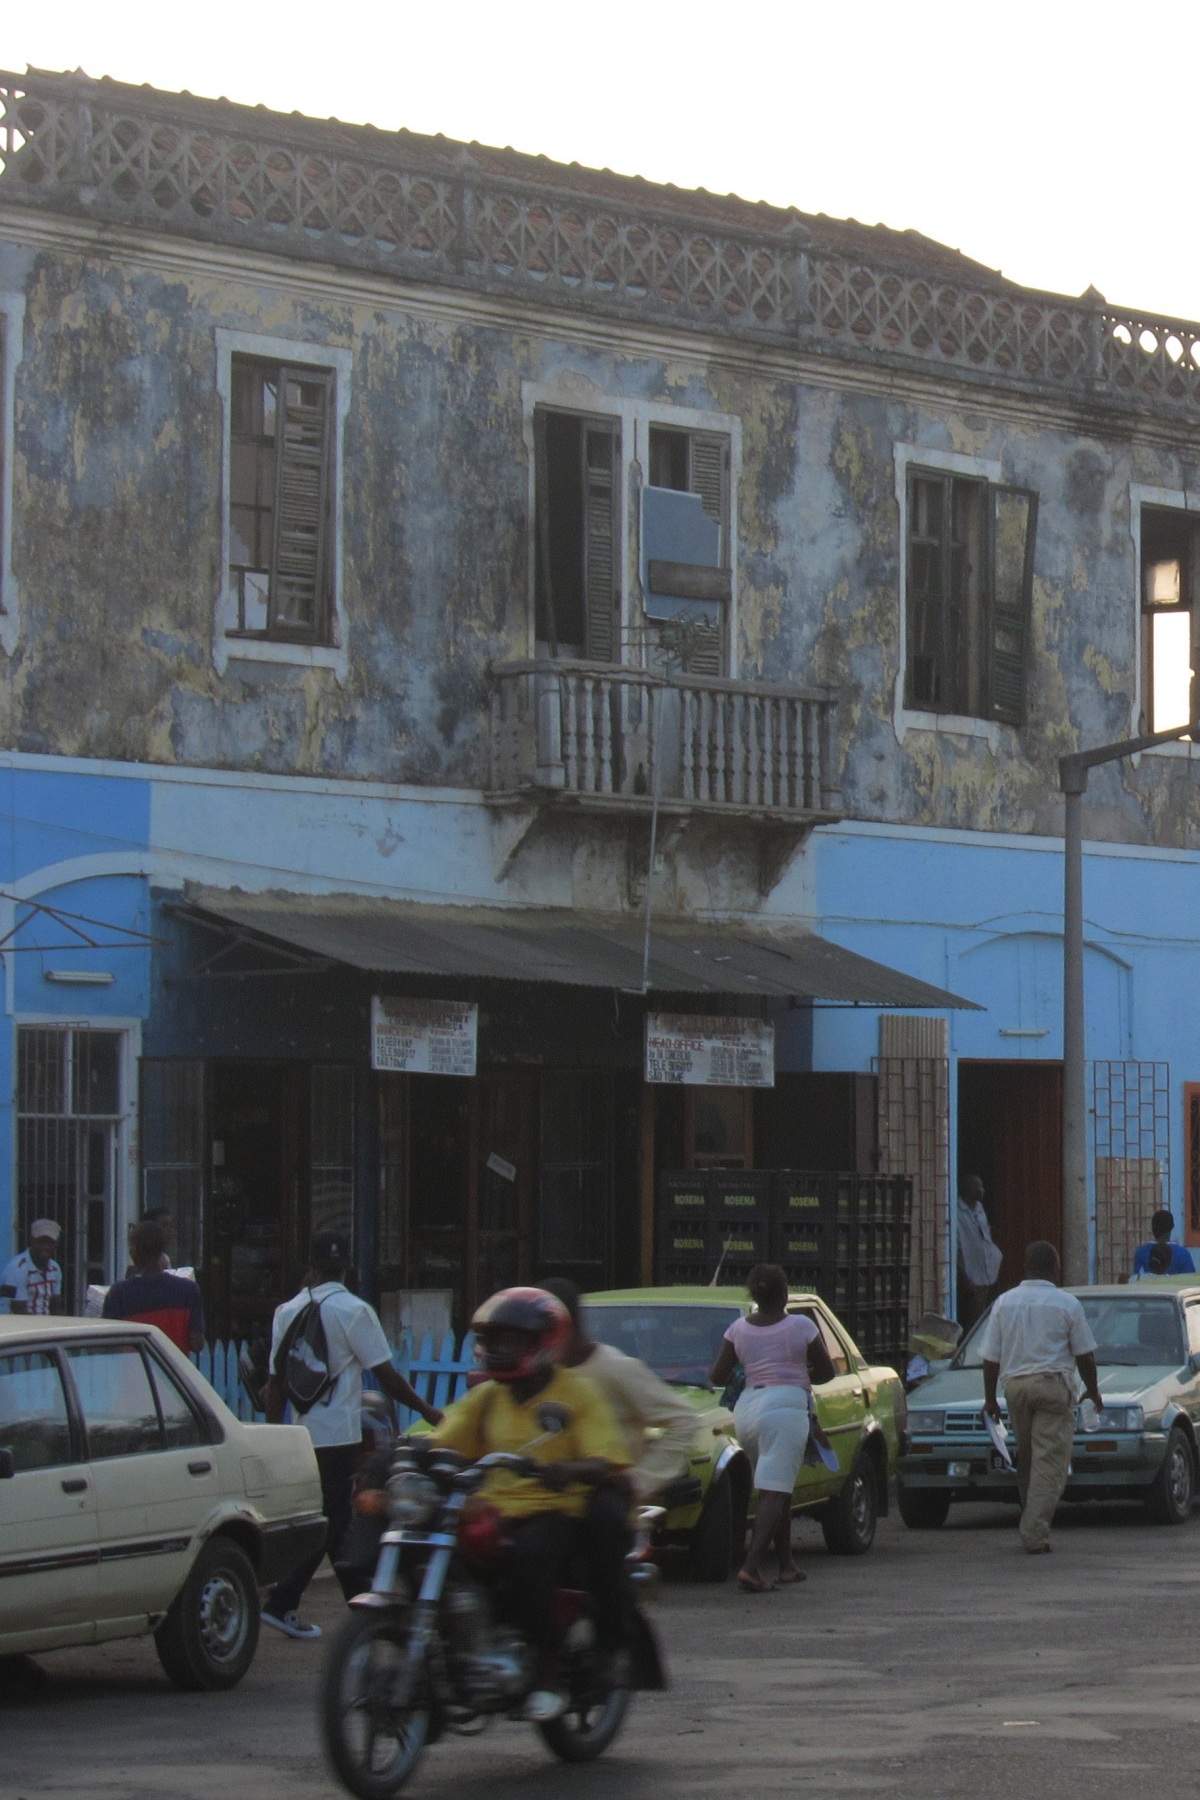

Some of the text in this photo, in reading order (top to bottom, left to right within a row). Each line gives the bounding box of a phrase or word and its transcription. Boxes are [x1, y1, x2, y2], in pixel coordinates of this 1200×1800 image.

[674, 1195, 705, 1205] ROSEMA
[724, 1195, 756, 1206] ROSEMA
[789, 1196, 820, 1208] ROSEMA
[673, 1239, 704, 1249] ROSEMA
[788, 1241, 819, 1252] ROSEMA
